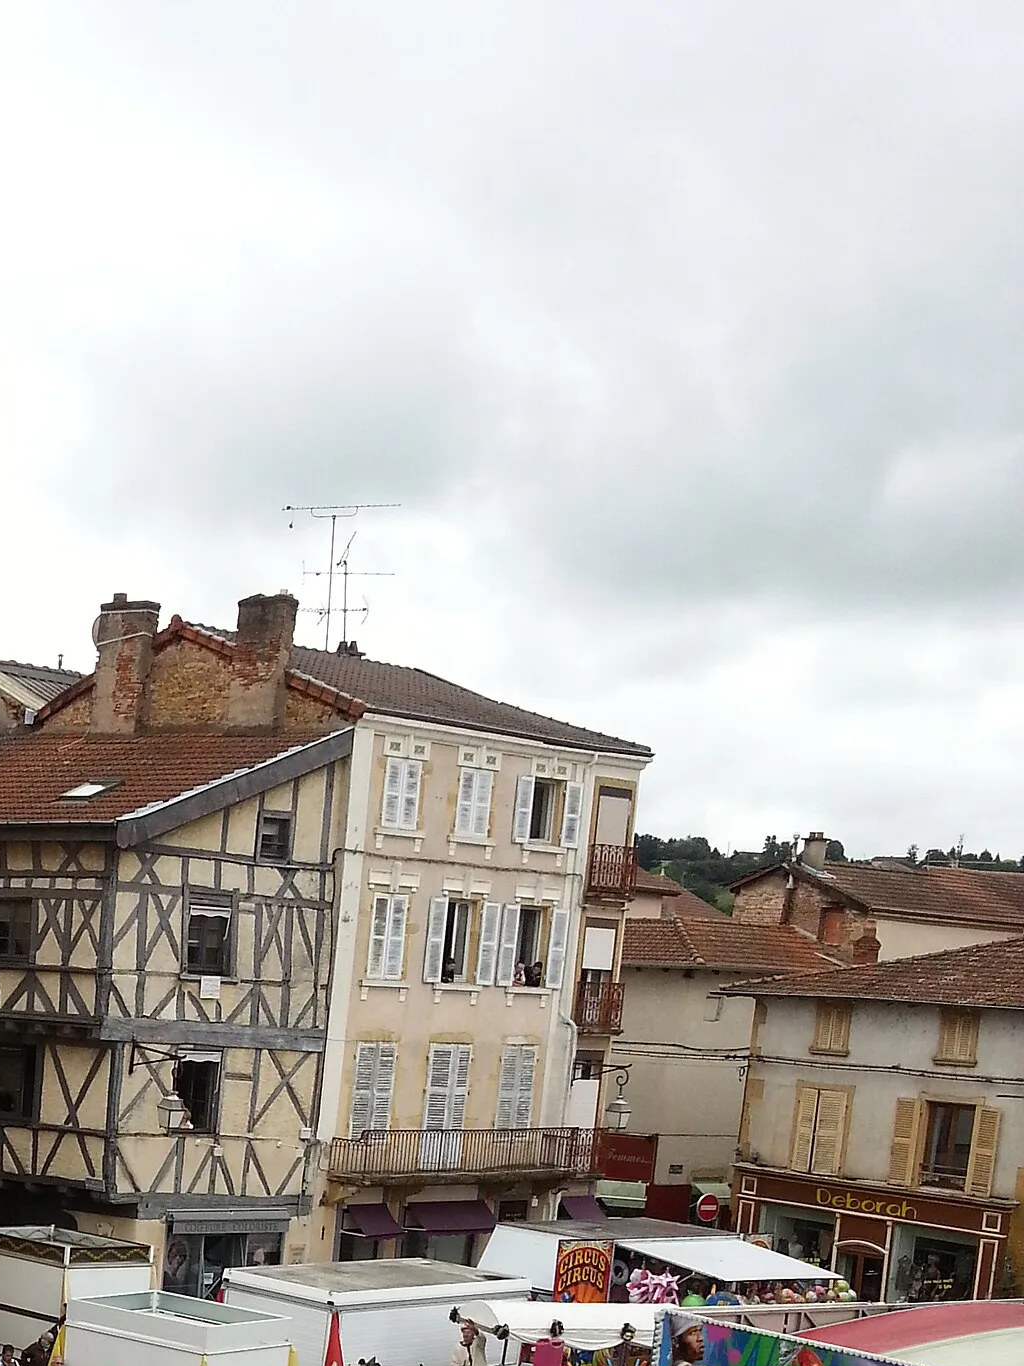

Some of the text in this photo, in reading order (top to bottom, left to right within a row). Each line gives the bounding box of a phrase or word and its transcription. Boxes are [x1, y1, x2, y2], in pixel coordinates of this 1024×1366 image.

[816, 1187, 917, 1220] Deborah
[184, 1222, 226, 1233] COIFFURE
[559, 1249, 606, 1274] CIRCUS
[557, 1266, 604, 1292] CIRCUS
